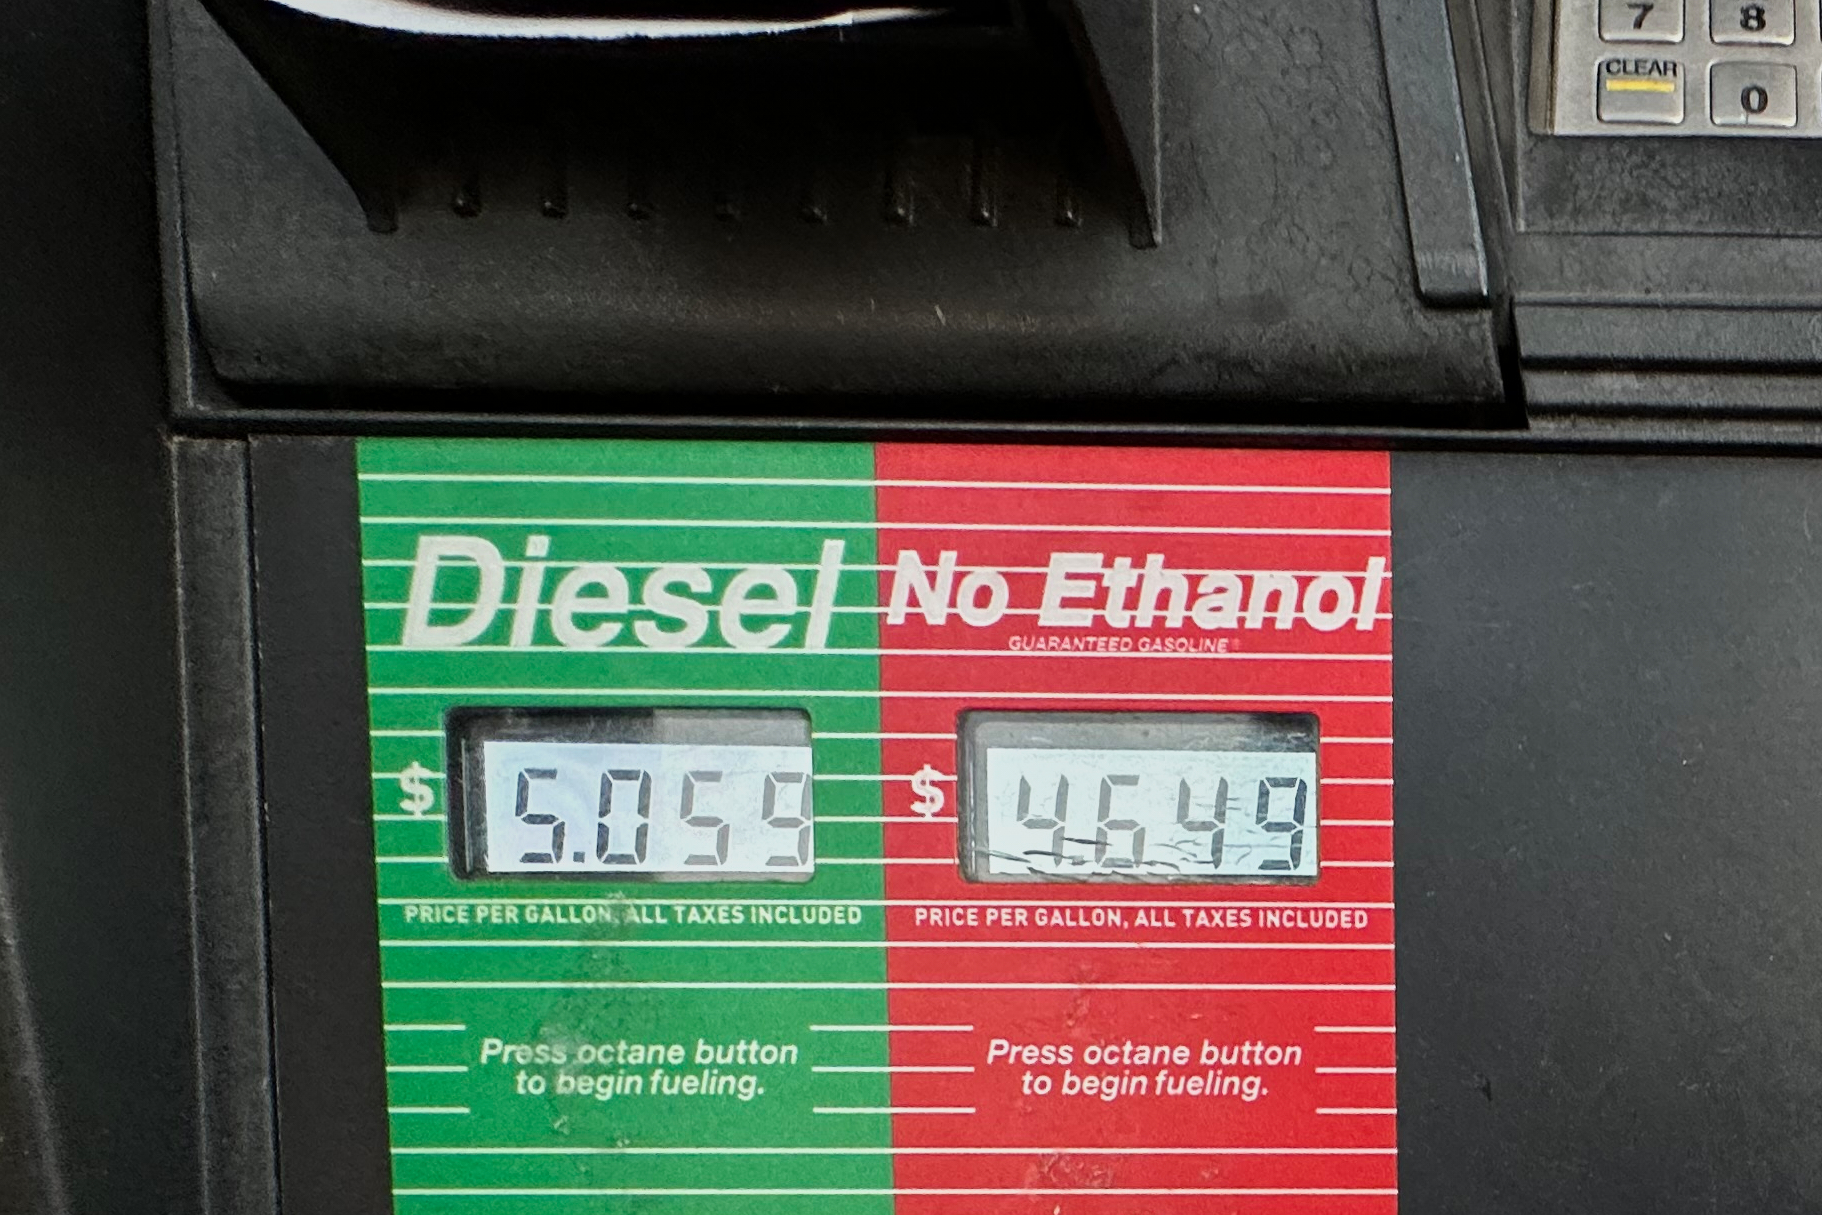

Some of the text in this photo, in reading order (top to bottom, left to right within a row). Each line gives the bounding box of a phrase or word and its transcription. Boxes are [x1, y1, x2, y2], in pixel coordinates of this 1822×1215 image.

[1627, 4, 1653, 30] 7
[1740, 4, 1766, 31] 8
[1606, 59, 1677, 77] CLEAR
[1741, 85, 1768, 113] 0
[401, 534, 845, 650] Diesel
[887, 549, 1386, 631] No Ethanol
[1009, 635, 1132, 651] GUARANTEED
[399, 761, 434, 816] $
[910, 764, 944, 816] $
[515, 768, 812, 866] 5.059
[404, 904, 468, 924] PRICE
[476, 905, 519, 924] PER
[627, 905, 667, 924] ALL
[675, 906, 744, 924] TAXES
[750, 906, 861, 924] INCLUDED
[915, 909, 1368, 930] PRICE PER GALLON, ALL TAXES INCLUDED
[480, 1038, 798, 1065] Press octane button
[987, 1039, 1302, 1065] Press octane button
[517, 1069, 764, 1100] to begin fueling.
[1022, 1070, 1268, 1101] to begin fueling.
